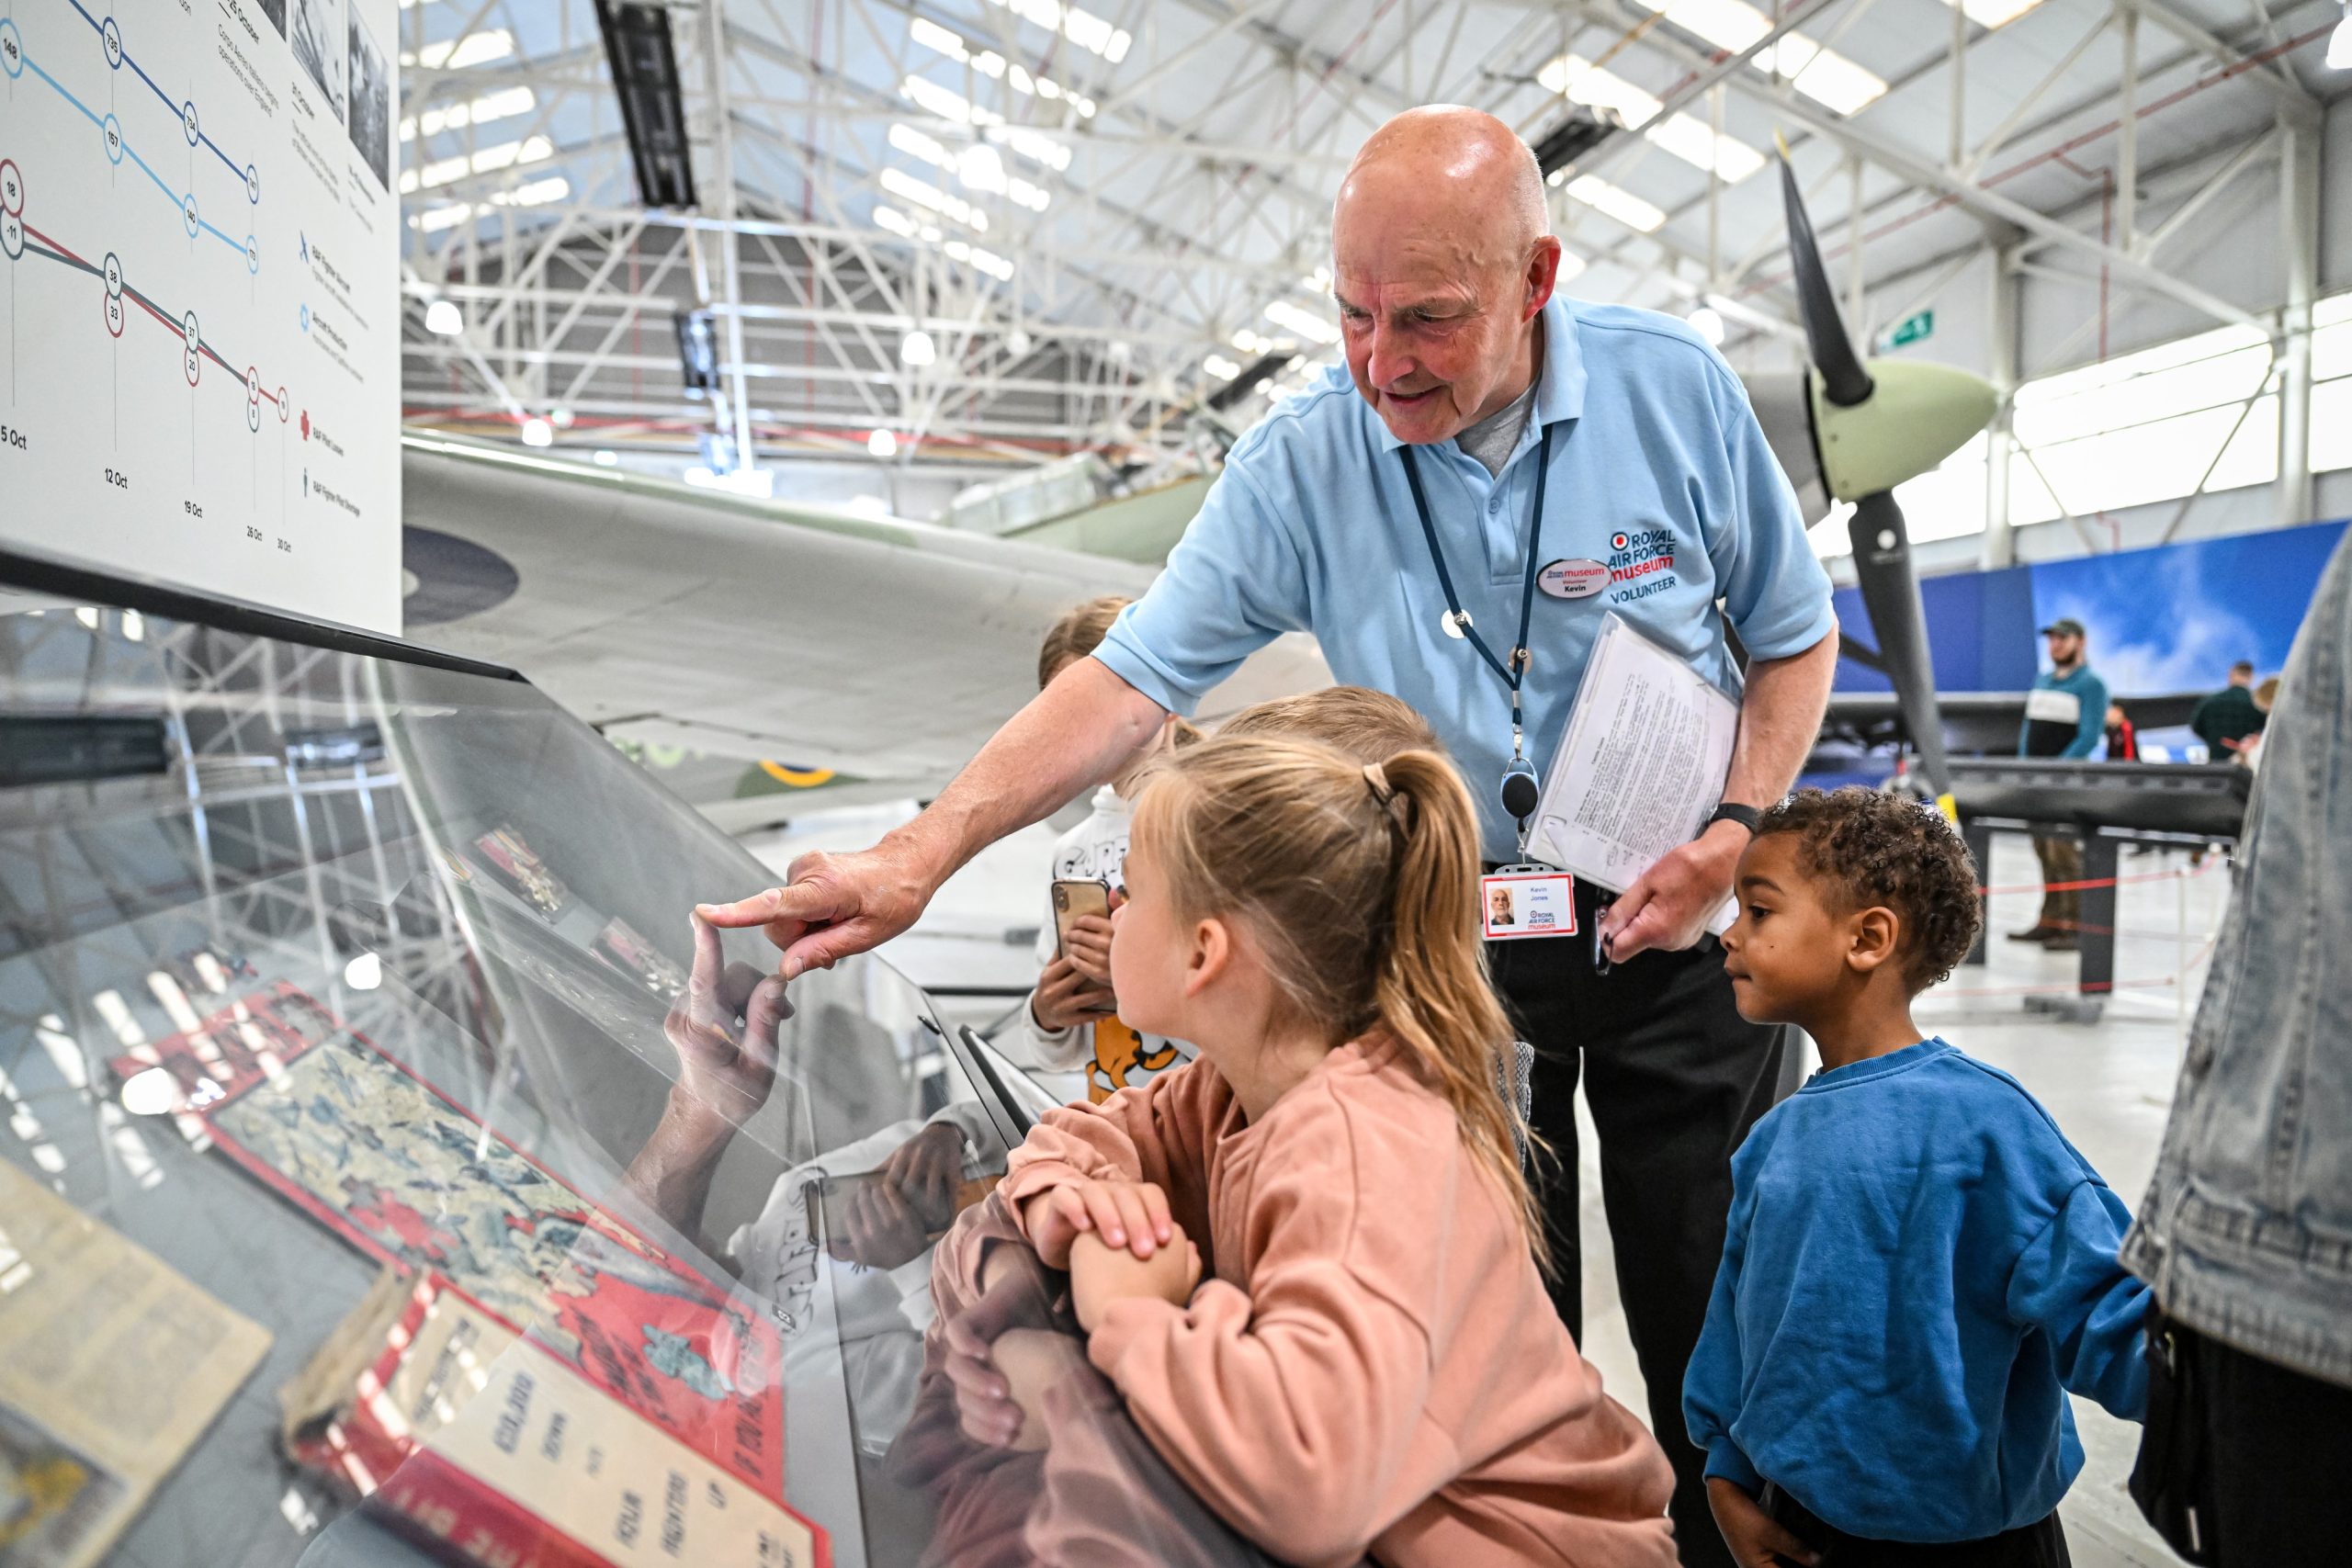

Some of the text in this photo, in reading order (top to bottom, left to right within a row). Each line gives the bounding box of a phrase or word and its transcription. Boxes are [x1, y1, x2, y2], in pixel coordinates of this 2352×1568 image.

[238, 7, 259, 45] October
[107, 33, 118, 53] 735
[218, 24, 234, 51] Corpo
[4, 38, 17, 60] 148
[187, 116, 196, 132] 734
[108, 130, 119, 147] 157
[6, 181, 16, 197] 18
[187, 209, 196, 223] 140
[6, 225, 17, 240] -11
[109, 269, 118, 283] 38
[110, 306, 118, 320] 33
[189, 326, 195, 338] 37
[1, 425, 27, 450] 5 Oct
[105, 468, 128, 490] 12 Oct
[185, 500, 202, 518] 19 Oct
[246, 525, 263, 541] 26 Oct
[1632, 529, 1676, 548] ROYAL
[277, 538, 291, 553] 30 Oct
[1609, 543, 1675, 569] AIR FORCE
[1565, 569, 1604, 577] museum
[1609, 556, 1674, 585] museum
[1611, 576, 1677, 604] VOLUNTEER
[707, 1479, 728, 1511] UP
